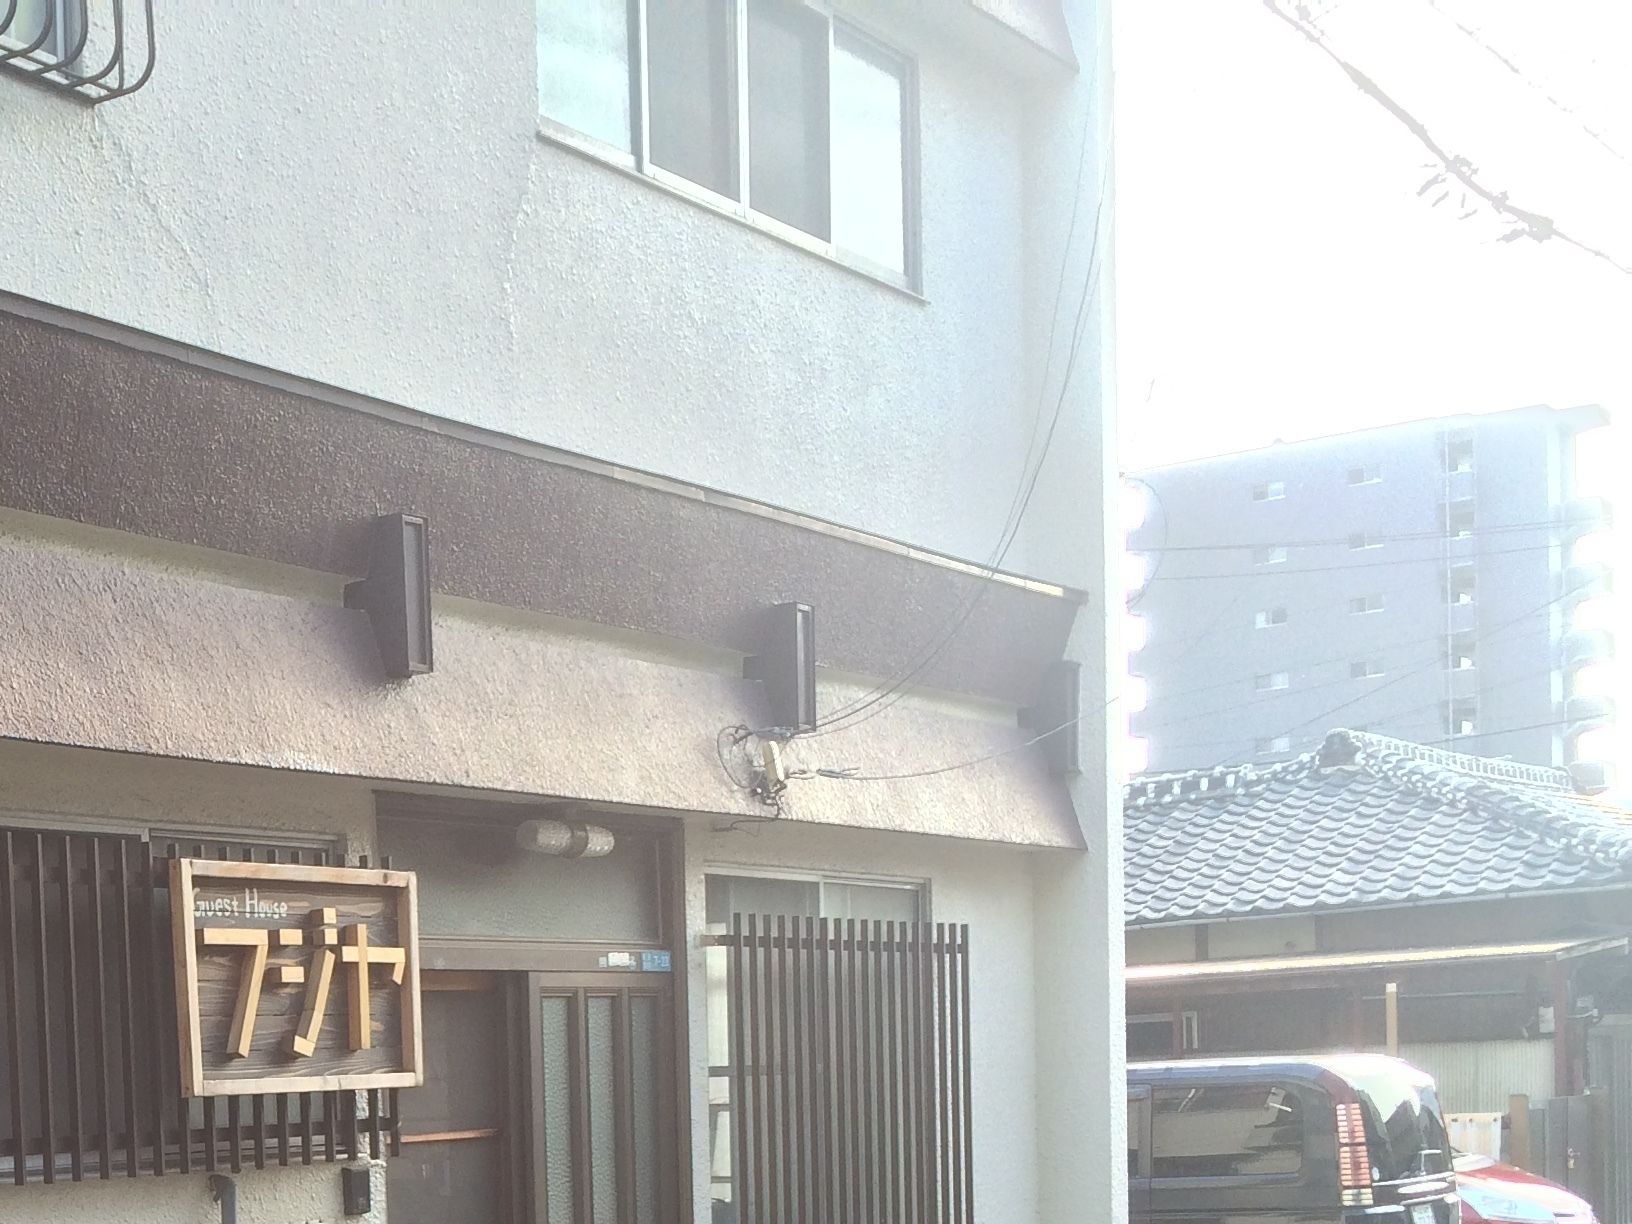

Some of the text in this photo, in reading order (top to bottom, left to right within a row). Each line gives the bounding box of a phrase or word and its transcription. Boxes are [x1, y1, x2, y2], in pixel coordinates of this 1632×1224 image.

[245, 887, 288, 920] House
[200, 907, 406, 1058] フジヤ
